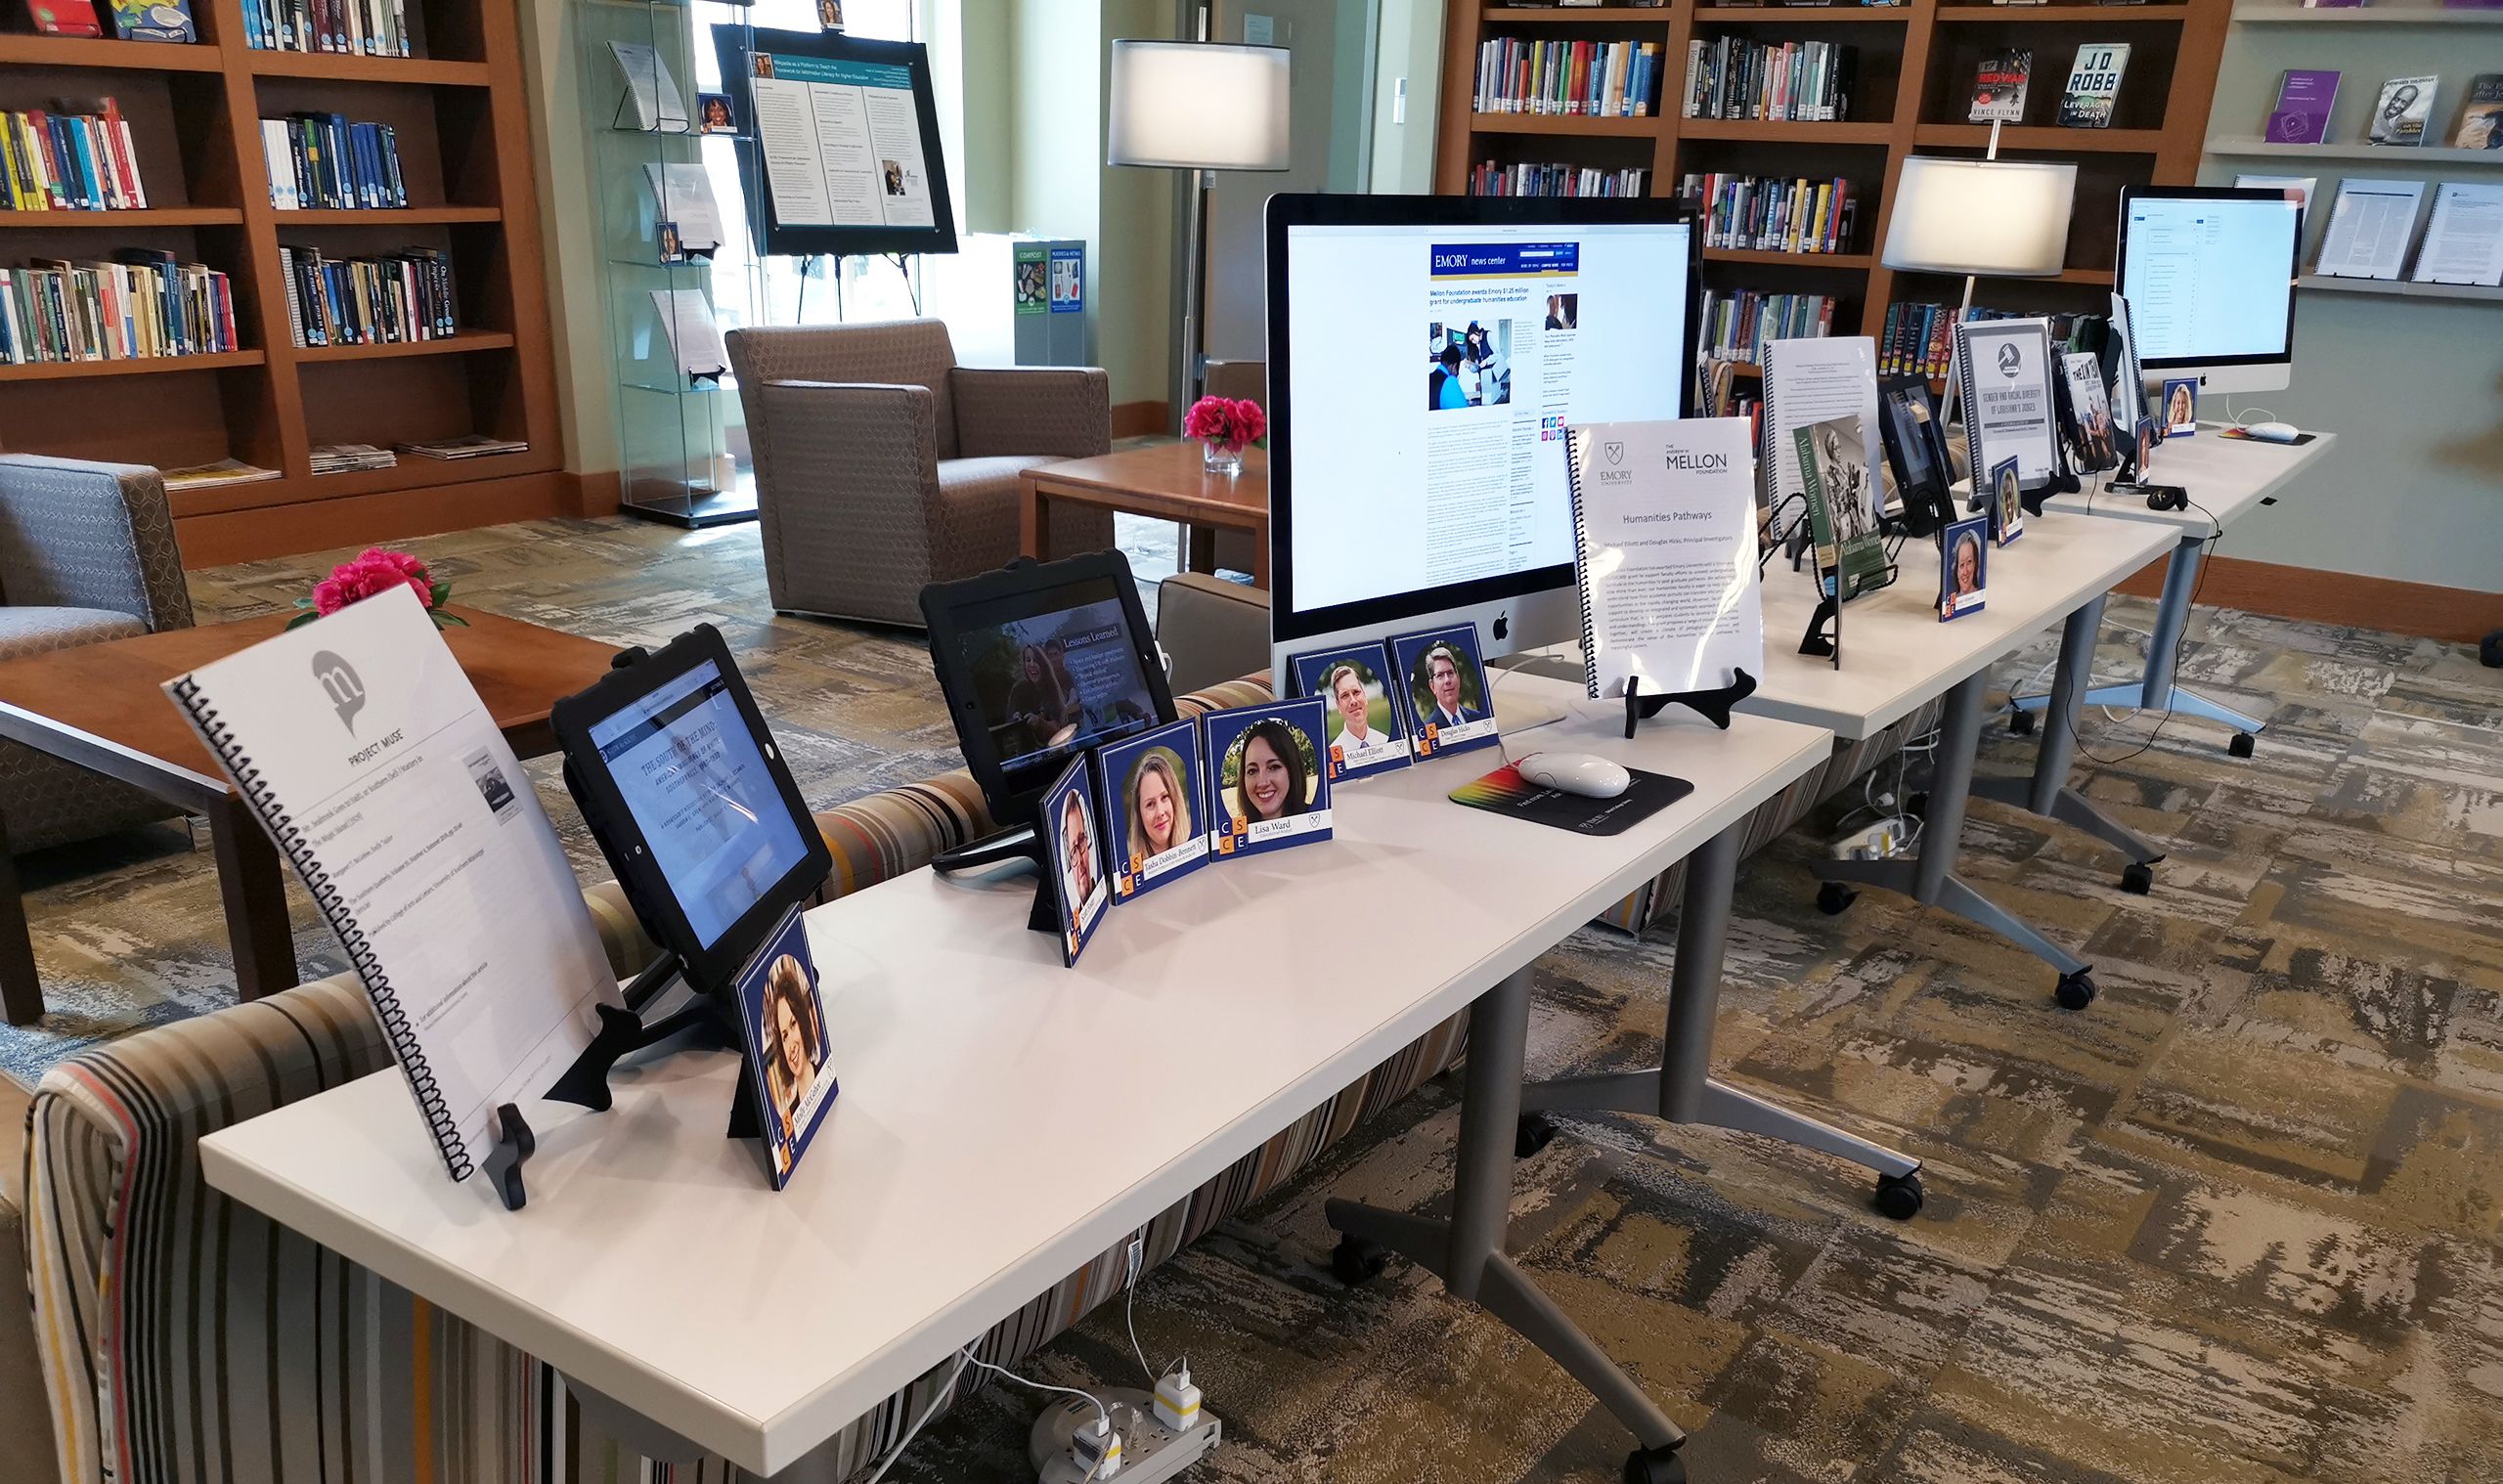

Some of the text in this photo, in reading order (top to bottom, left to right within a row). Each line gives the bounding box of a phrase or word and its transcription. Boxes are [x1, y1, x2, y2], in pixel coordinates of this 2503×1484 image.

[2069, 73, 2117, 91] ROBB
[2064, 100, 2105, 109] LEVERAGE
[2079, 109, 2107, 118] DEATH
[1435, 254, 1468, 268] EMORY
[1487, 256, 1506, 265] center
[1429, 297, 1441, 306] grant
[1983, 392, 1998, 402] GENDER
[1666, 454, 1728, 470] MELLON
[1601, 470, 1632, 481] EMORY
[1798, 438, 1821, 516] Alabama Women
[1623, 511, 1712, 524] Humanities Pathways
[1840, 541, 1865, 556] Alabama
[1064, 627, 1119, 648] Lessons Learned
[1419, 725, 1434, 738] C S
[1441, 727, 1459, 737] Douglas
[348, 728, 404, 767] PROJECT MUSE
[1334, 749, 1339, 759] S
[1347, 747, 1383, 761] Michael Elliott
[1422, 741, 1437, 753] C E
[641, 760, 657, 776] THE
[657, 748, 677, 768] SOUTH
[686, 733, 698, 748] THE
[1338, 763, 1343, 772] E
[1222, 819, 1243, 833] C S
[1255, 820, 1291, 835] Lisa Ward
[1223, 836, 1244, 851] C E
[1145, 843, 1197, 872] Tasha Dobbin-Bennett
[1122, 859, 1139, 874] C S
[1124, 875, 1141, 891] C E
[777, 1115, 790, 1143] C S
[783, 1138, 795, 1165] C E
